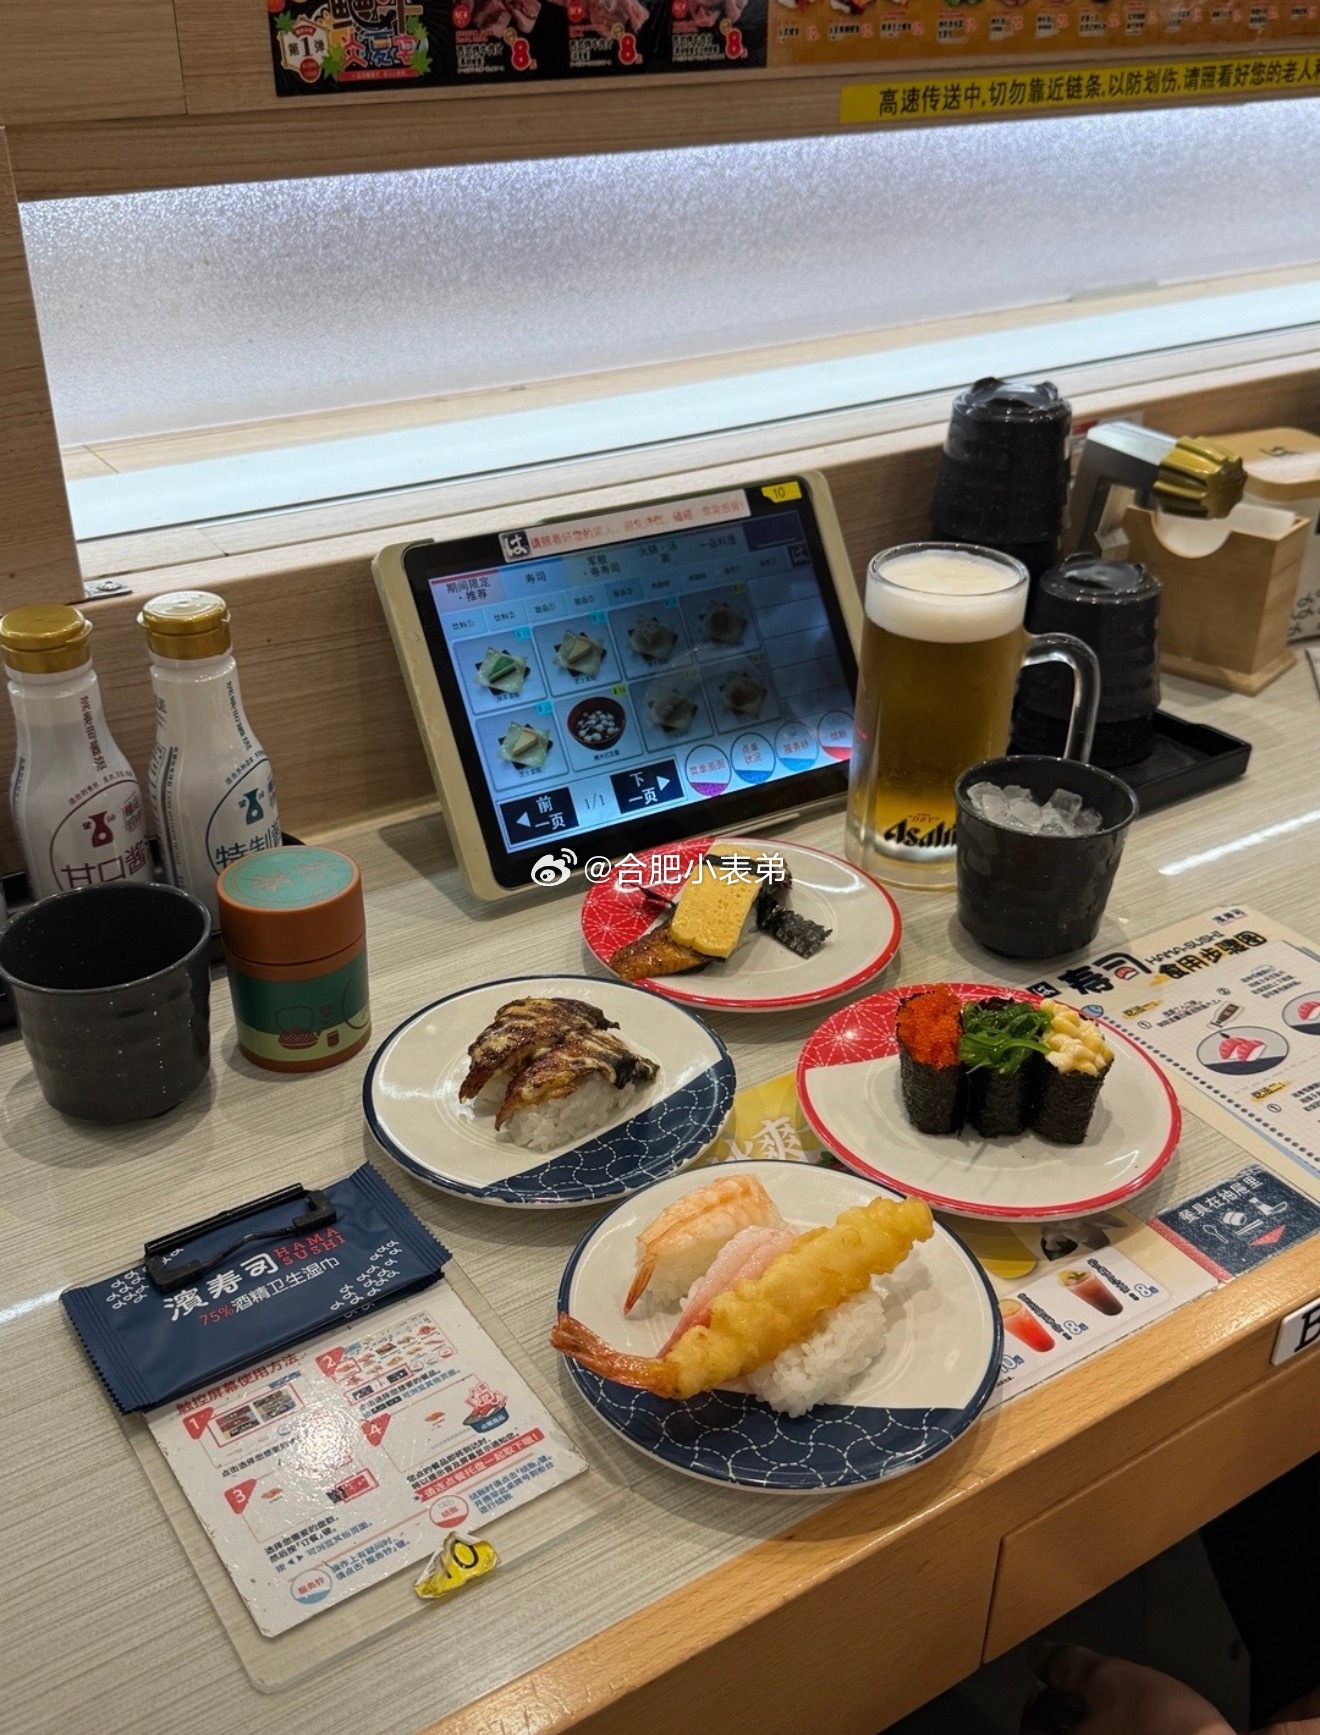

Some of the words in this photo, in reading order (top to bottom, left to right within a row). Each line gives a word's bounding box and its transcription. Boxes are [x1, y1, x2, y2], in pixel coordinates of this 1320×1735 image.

[773, 488, 786, 499] 10
[504, 534, 529, 557] は
[525, 571, 547, 584] 寿司
[536, 796, 553, 812] 前
[629, 787, 658, 805] 一页
[534, 812, 566, 831] 一页
[1178, 1175, 1265, 1223] 餐具在抽屉里
[273, 1226, 339, 1259] HAMA
[282, 1235, 347, 1266] SUSHI
[199, 1255, 341, 1326] 75%酒精卫生湿巾
[324, 1355, 337, 1369] 2
[176, 1352, 300, 1416] 触控屏幕使用方法
[189, 1417, 198, 1431] 1
[369, 1423, 384, 1436] 4
[233, 1489, 246, 1503] 3
